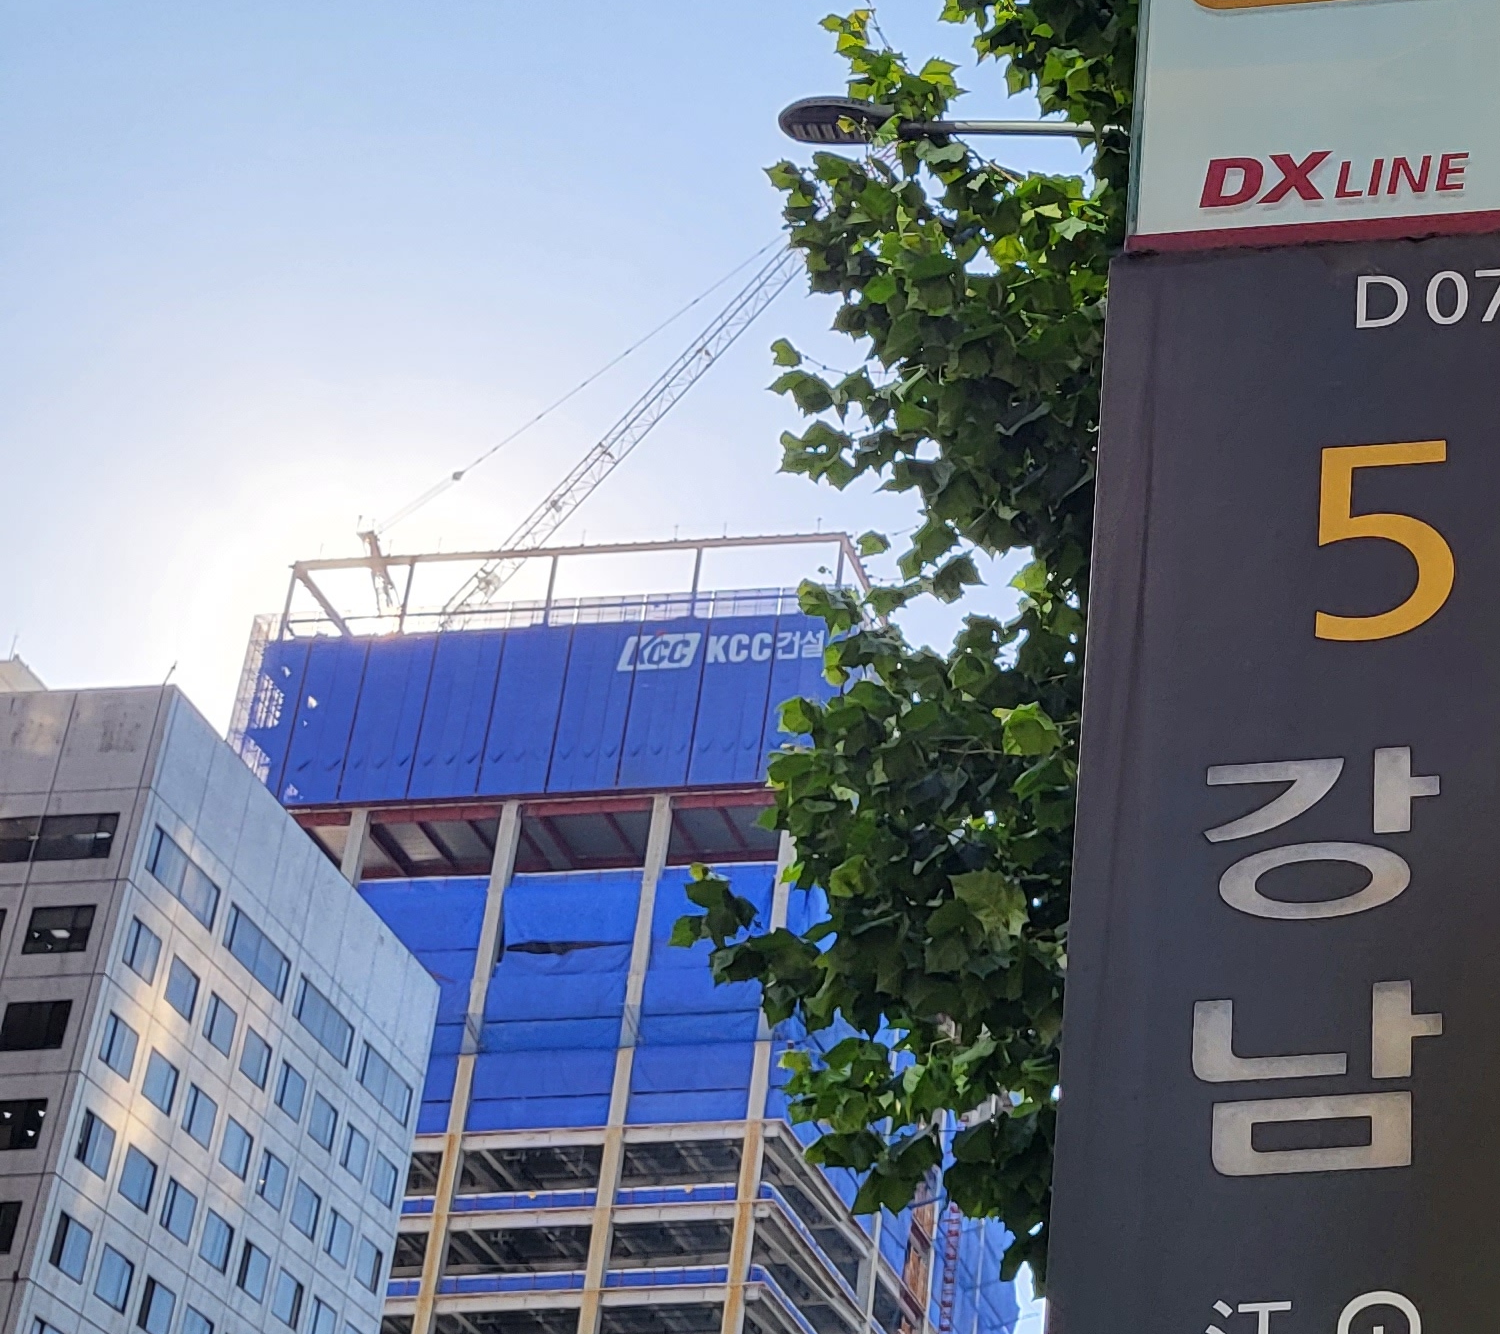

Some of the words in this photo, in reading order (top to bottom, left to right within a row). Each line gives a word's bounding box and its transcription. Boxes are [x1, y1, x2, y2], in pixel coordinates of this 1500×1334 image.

[1313, 439, 1455, 642] 5
[705, 629, 825, 665] KCC건설
[1191, 745, 1443, 1177] 강남
